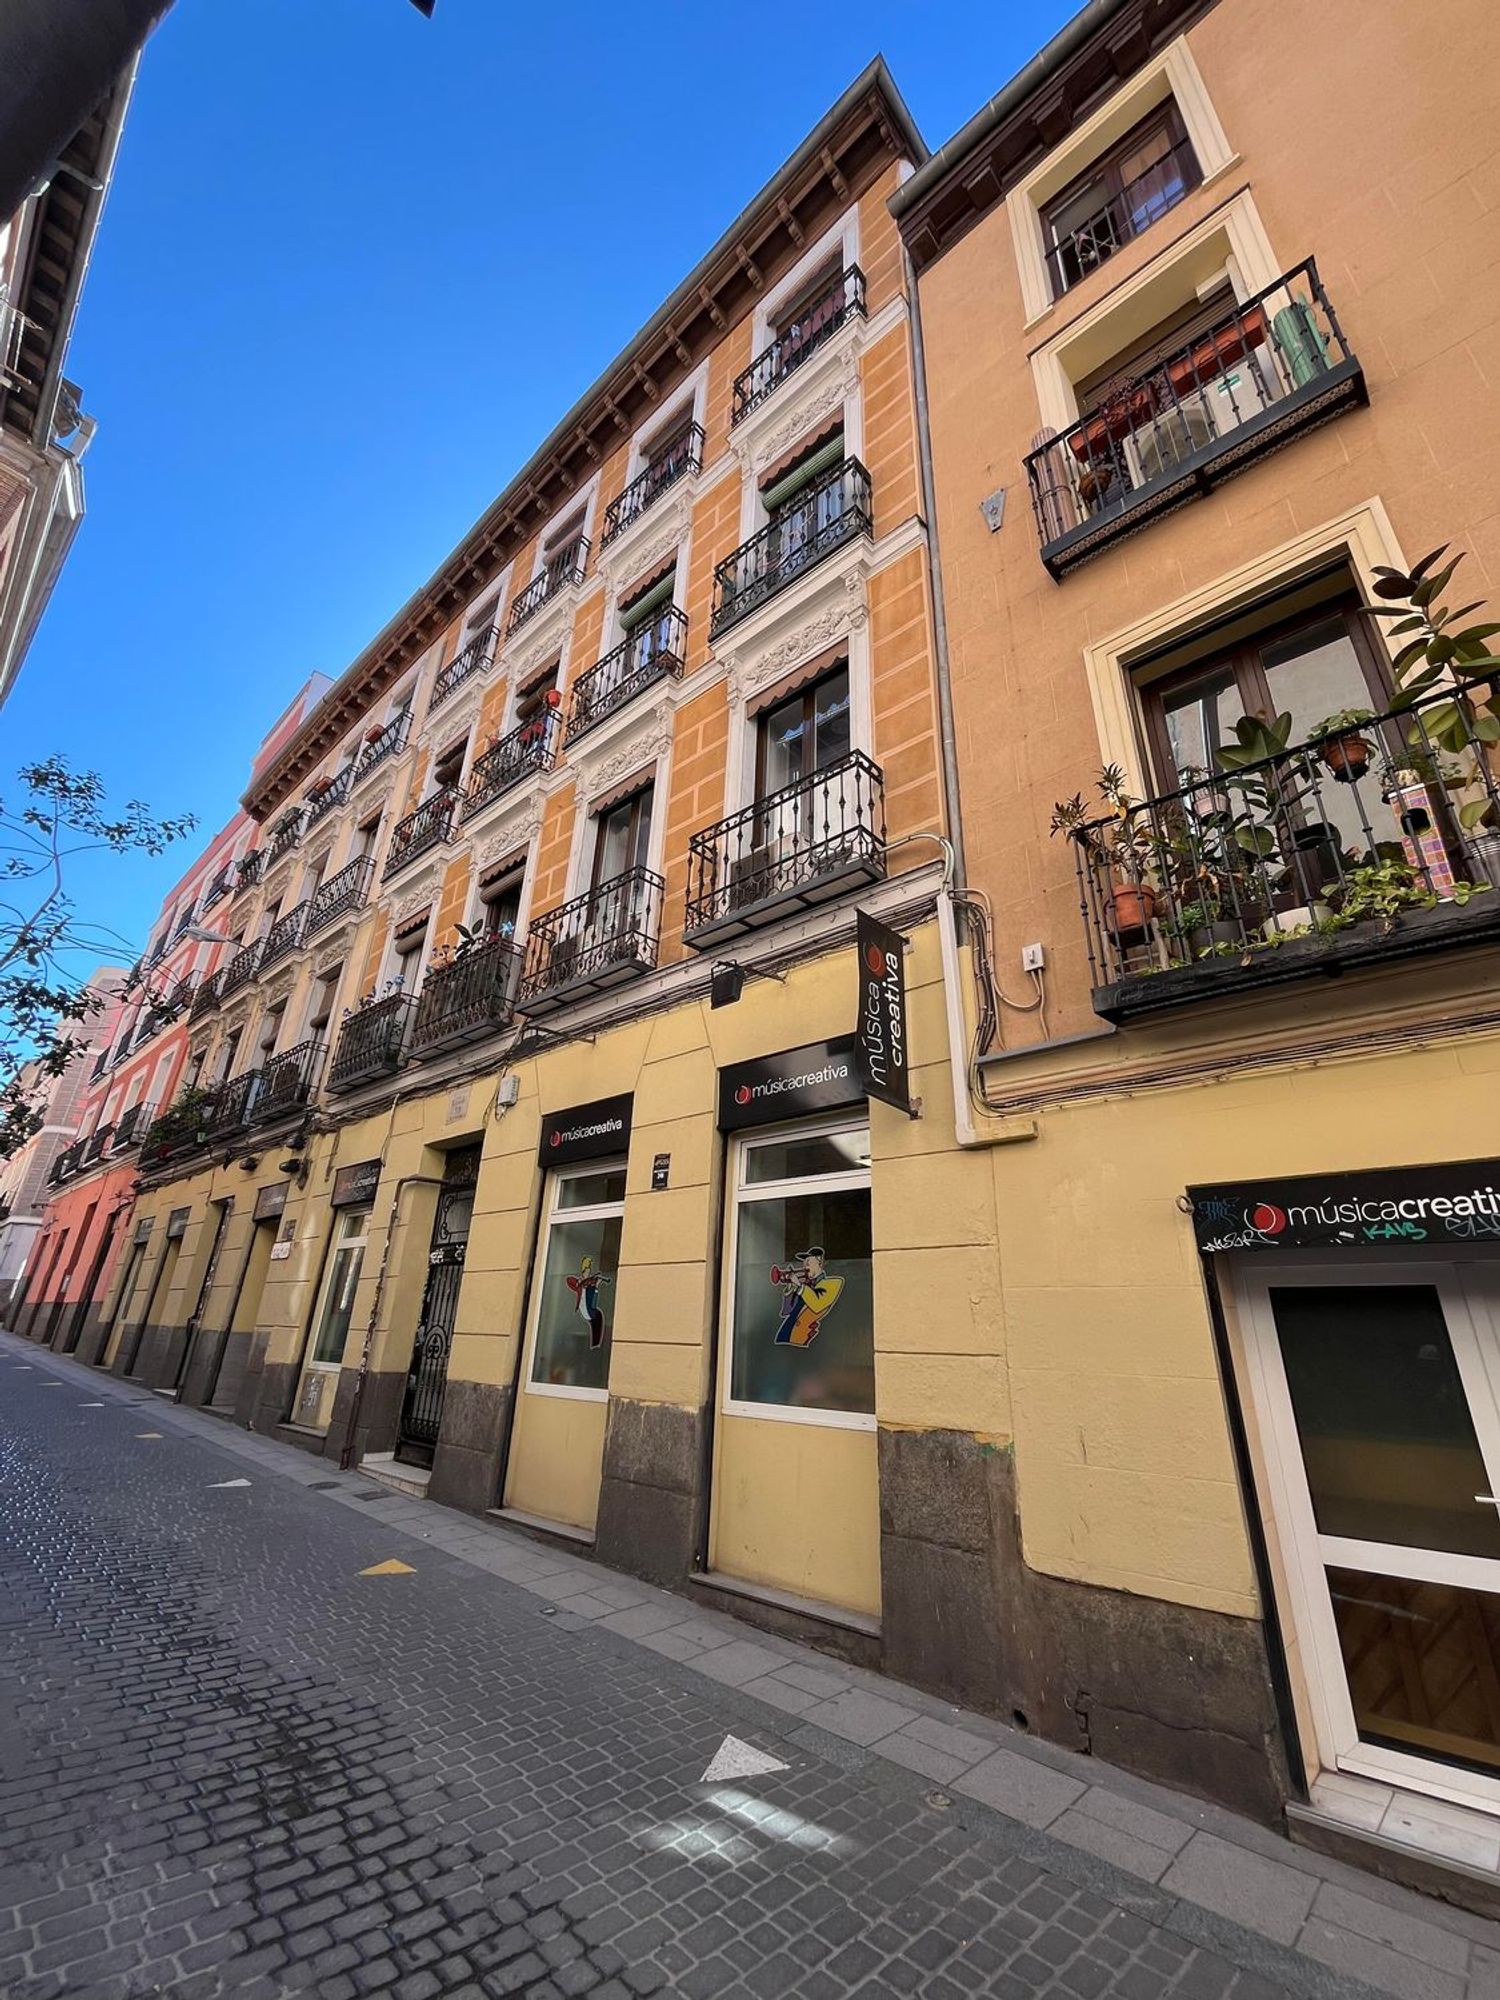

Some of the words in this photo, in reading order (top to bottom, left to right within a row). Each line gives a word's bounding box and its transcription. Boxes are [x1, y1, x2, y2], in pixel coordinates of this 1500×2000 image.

[862, 981, 887, 1086] música
[882, 951, 903, 1067] creativa
[751, 1064, 849, 1099] músicacreativa
[1287, 1186, 1500, 1226] músicacreati
